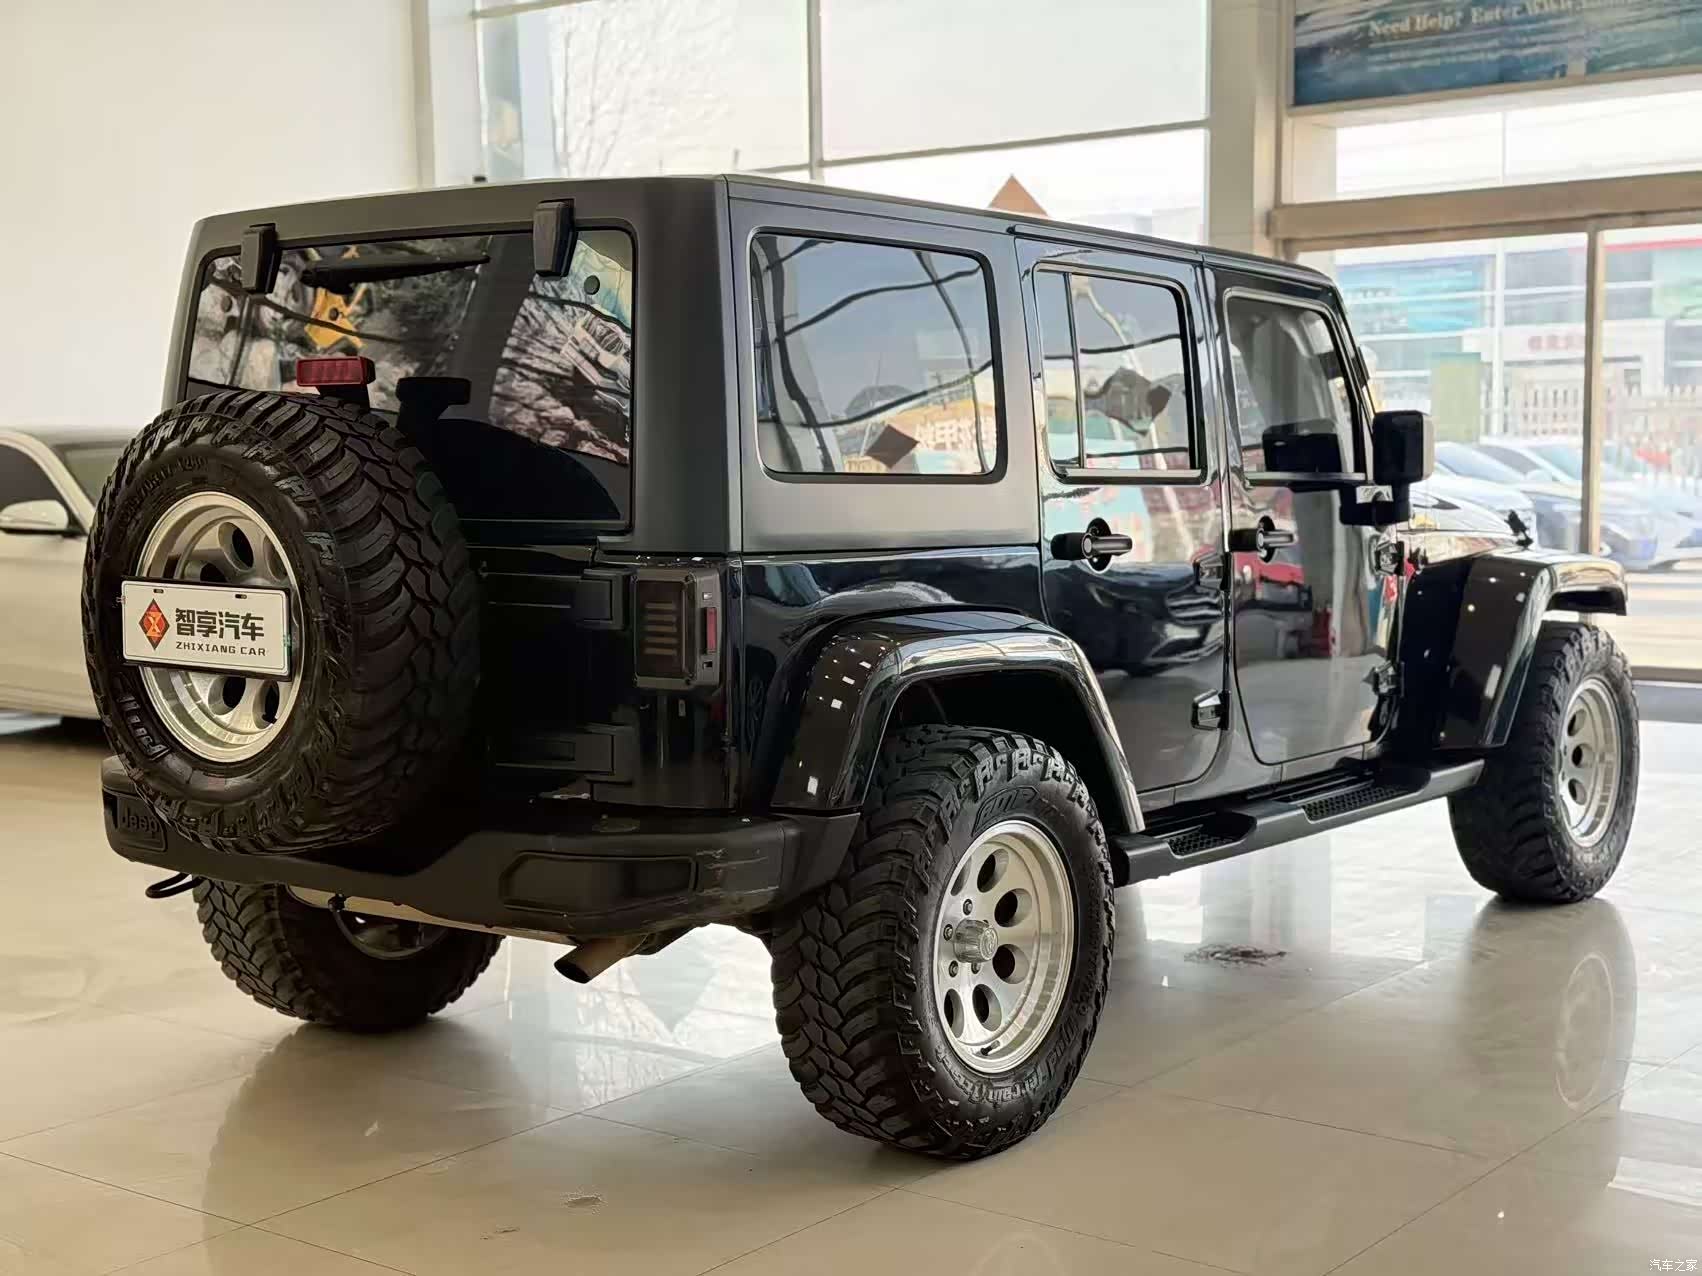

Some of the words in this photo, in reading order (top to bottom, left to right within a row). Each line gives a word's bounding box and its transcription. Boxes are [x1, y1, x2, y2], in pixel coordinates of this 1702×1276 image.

[175, 608, 265, 641] 智享汽车
[175, 641, 236, 654] ZHIXIANG
[240, 646, 266, 657] CAR
